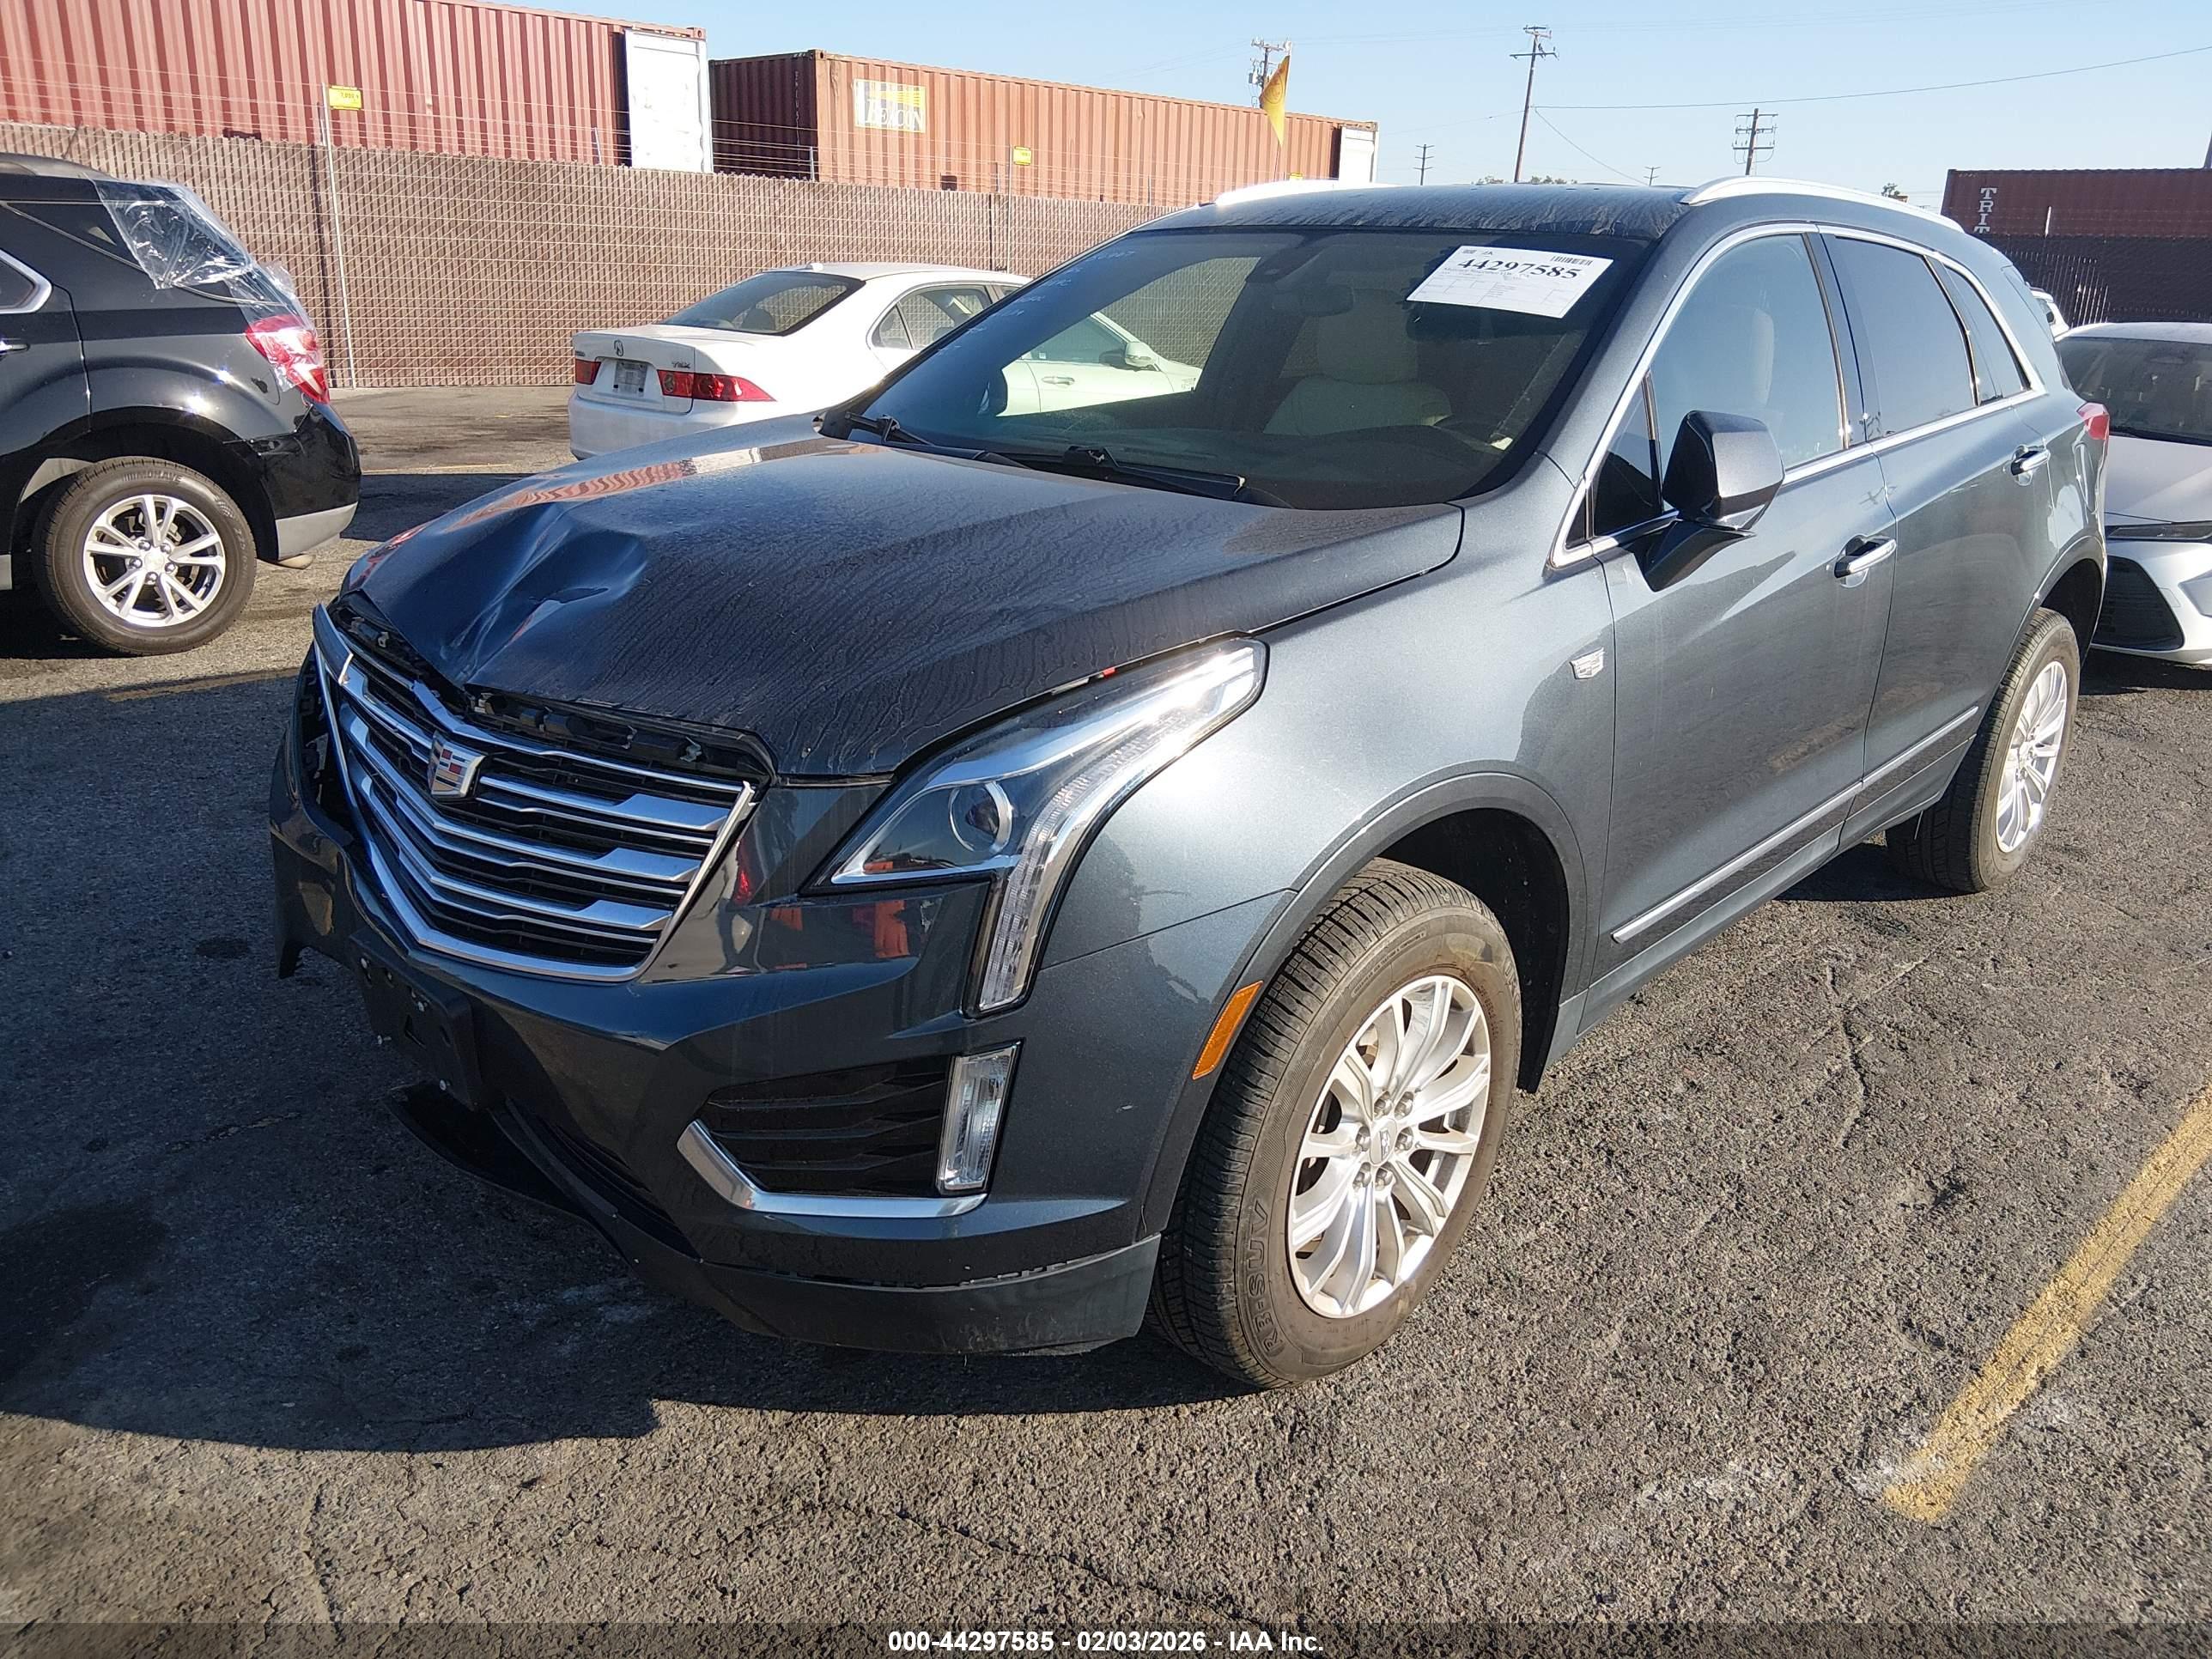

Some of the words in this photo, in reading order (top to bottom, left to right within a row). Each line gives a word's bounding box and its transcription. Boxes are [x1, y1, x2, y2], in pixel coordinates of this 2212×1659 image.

[1974, 187, 1997, 234] TRIT
[1457, 258, 1583, 279] 44297585
[1248, 1200, 1284, 1352] RB-SUV
